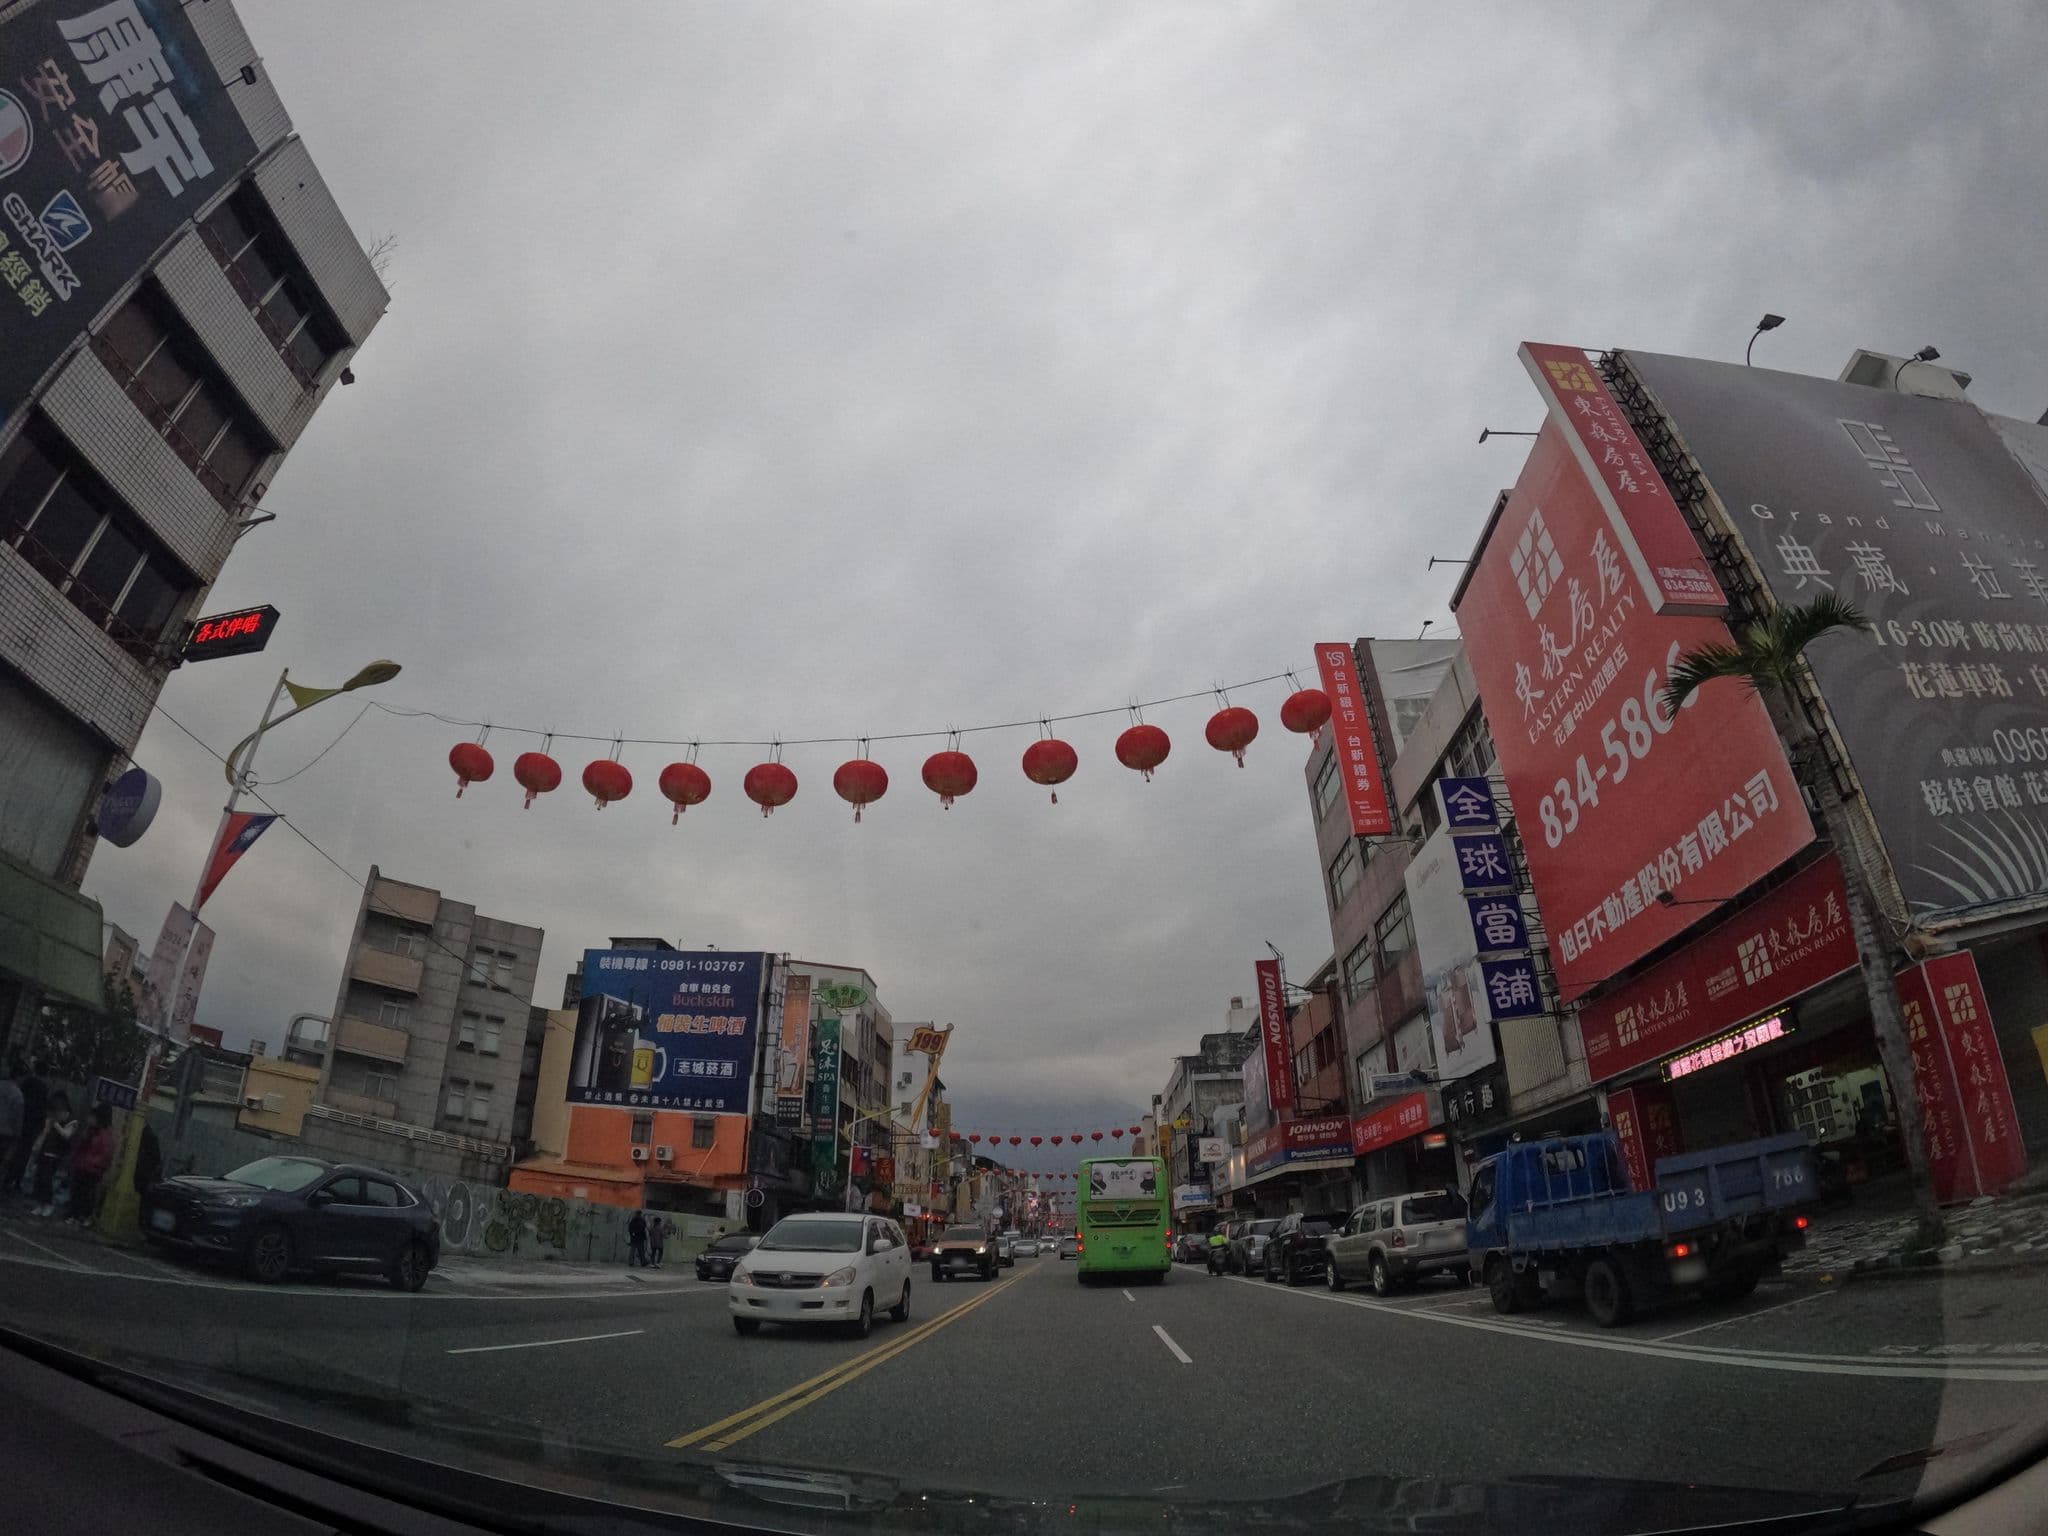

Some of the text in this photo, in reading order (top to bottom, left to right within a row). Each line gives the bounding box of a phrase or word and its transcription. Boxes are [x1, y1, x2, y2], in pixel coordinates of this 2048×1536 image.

[56, 0, 215, 198] 康宇
[3, 193, 80, 302] SHARK
[1751, 503, 1890, 531] Grand
[1513, 527, 1625, 721] 東森房屋
[1528, 586, 1636, 745] EASTERN REALTY
[1557, 767, 1780, 966] 旭日不動產股份有限公司
[656, 1013, 747, 1036] 桶裝生啤酒
[915, 1031, 942, 1050] 199
[1261, 970, 1282, 1045] JOHNSON
[817, 1072, 836, 1082] SPA
[1288, 1120, 1345, 1137] JOHNSON
